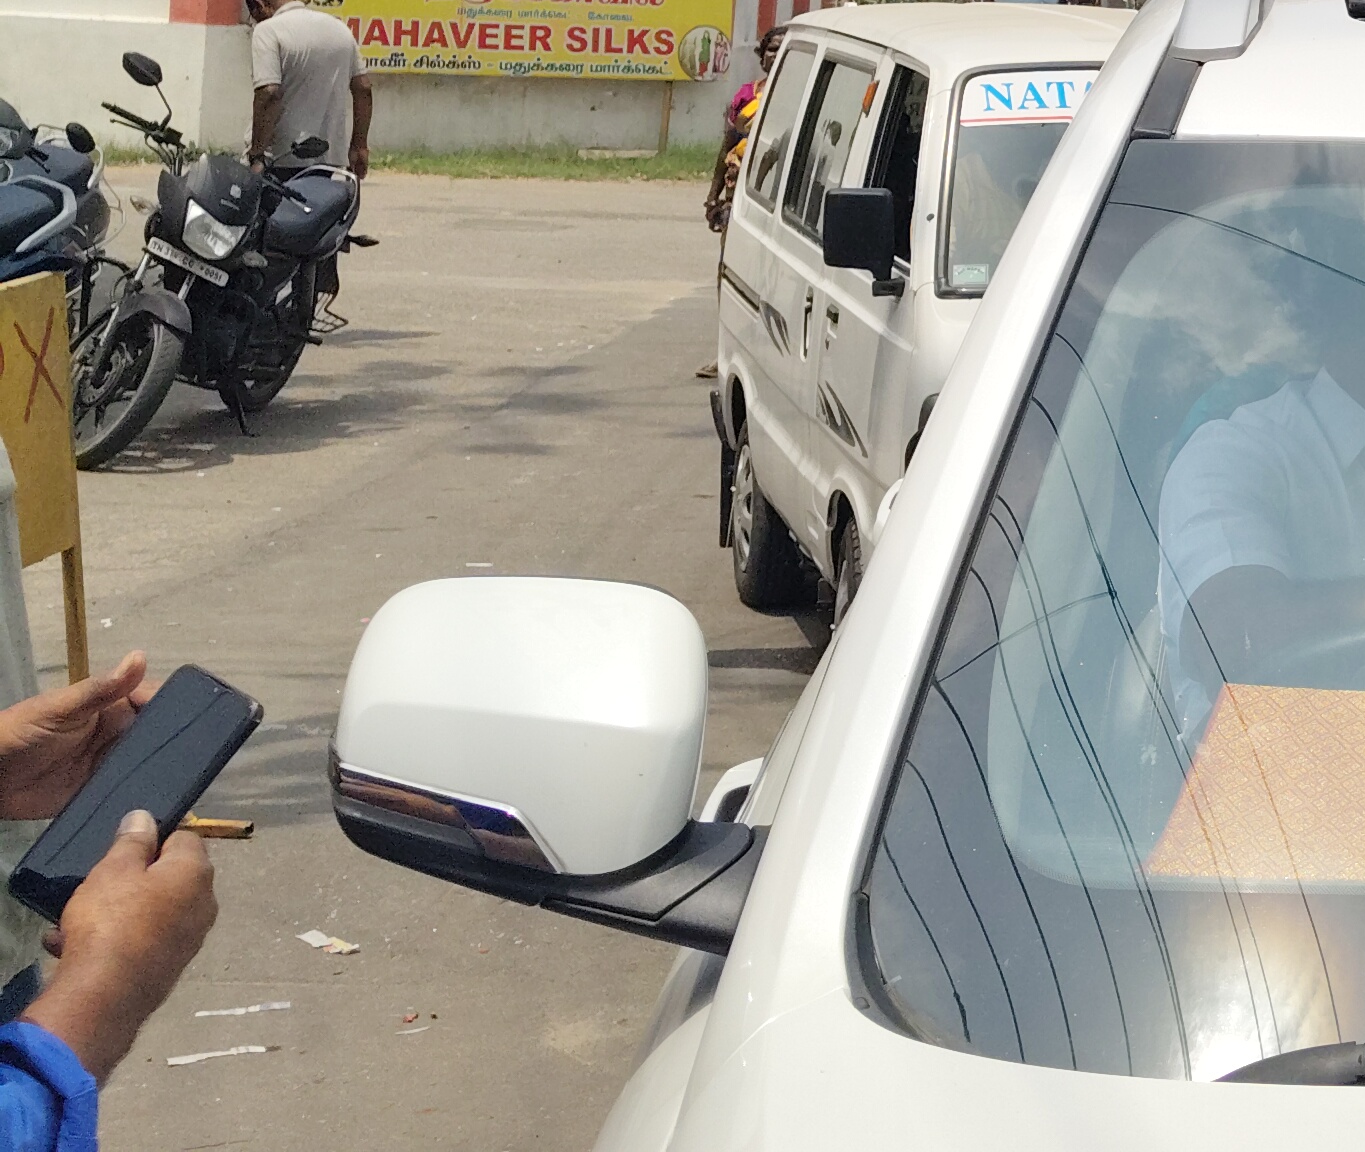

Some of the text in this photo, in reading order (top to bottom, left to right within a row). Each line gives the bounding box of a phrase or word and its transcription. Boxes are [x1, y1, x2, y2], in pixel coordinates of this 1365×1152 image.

[566, 25, 675, 56] SILKS
[413, 54, 481, 70] சில்க்ஸ்
[499, 57, 585, 74] மதுக்கரை
